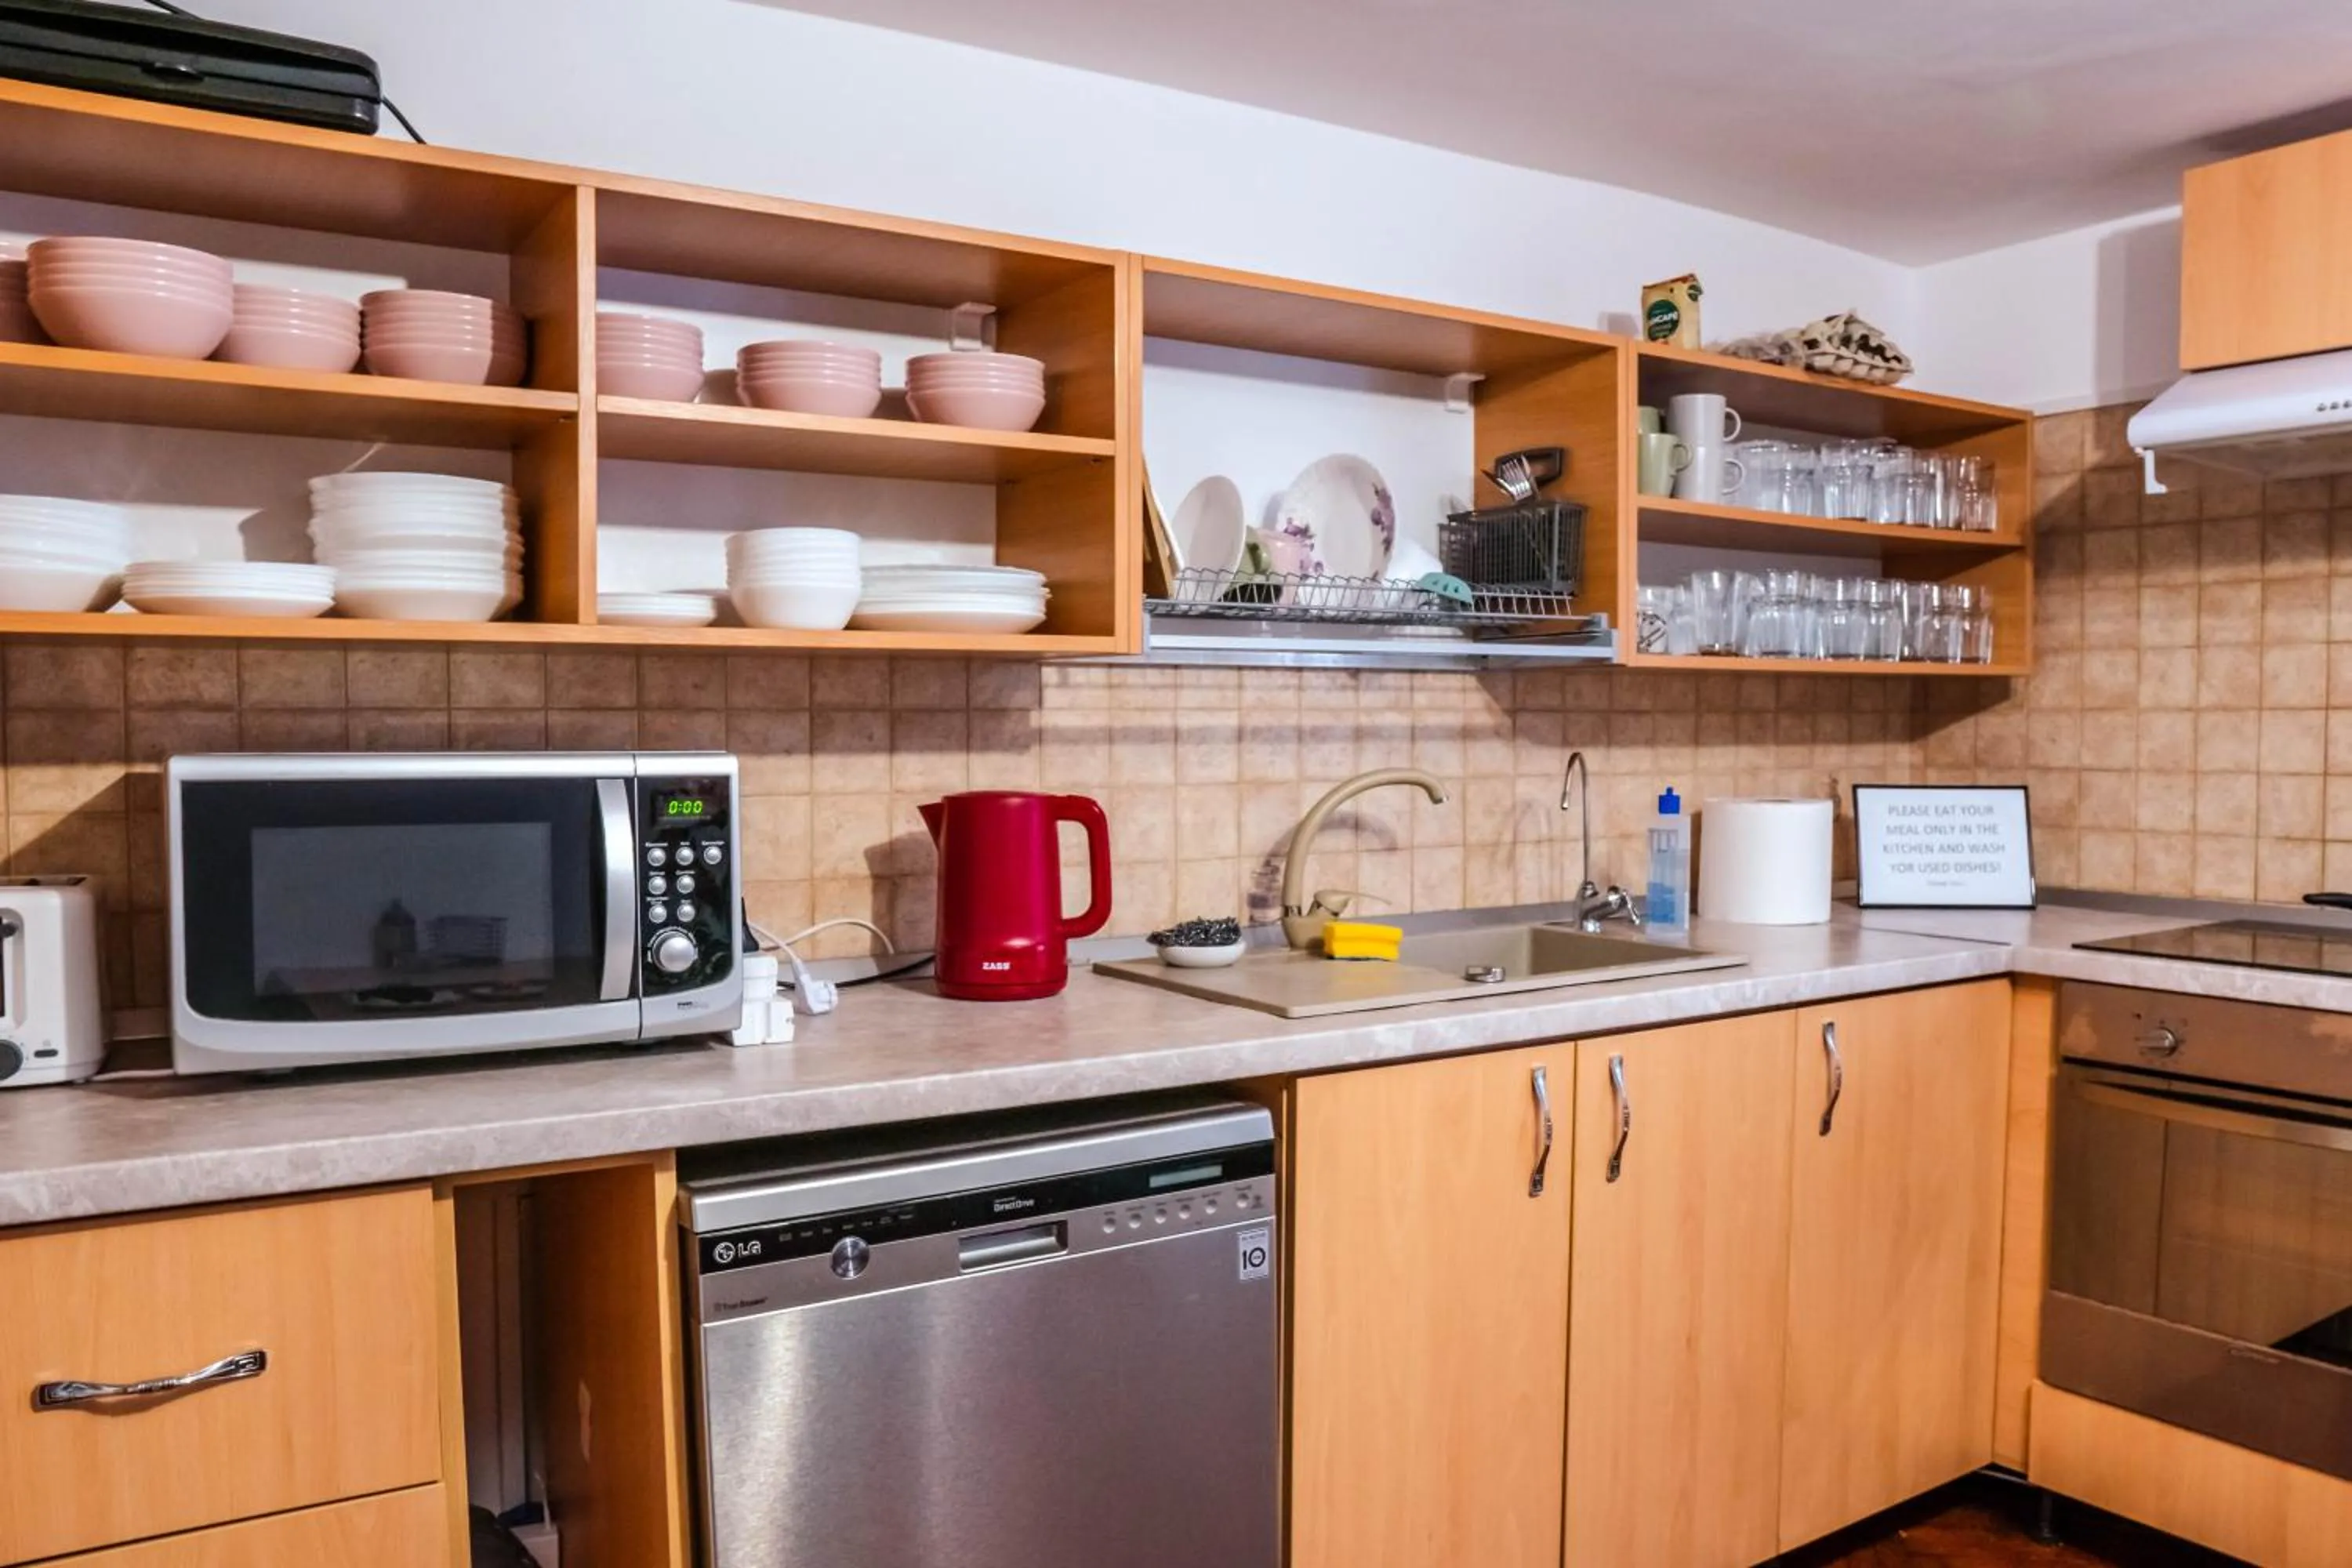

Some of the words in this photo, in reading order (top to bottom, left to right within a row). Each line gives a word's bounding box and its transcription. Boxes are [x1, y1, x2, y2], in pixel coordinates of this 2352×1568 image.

[669, 800, 703, 814] 0:00
[1888, 804, 1929, 816] PLEASE
[1934, 804, 1956, 817] EAT
[1960, 804, 1994, 816] YOUR
[1886, 823, 1919, 835] MEAL
[1923, 824, 1955, 835] ONLY
[1959, 824, 1973, 835] IN
[1976, 823, 1999, 835] THE
[1882, 843, 1934, 854] KITCHEN
[1938, 843, 1965, 854] AND
[1968, 843, 2006, 854] WASH
[1918, 862, 1951, 873] USED
